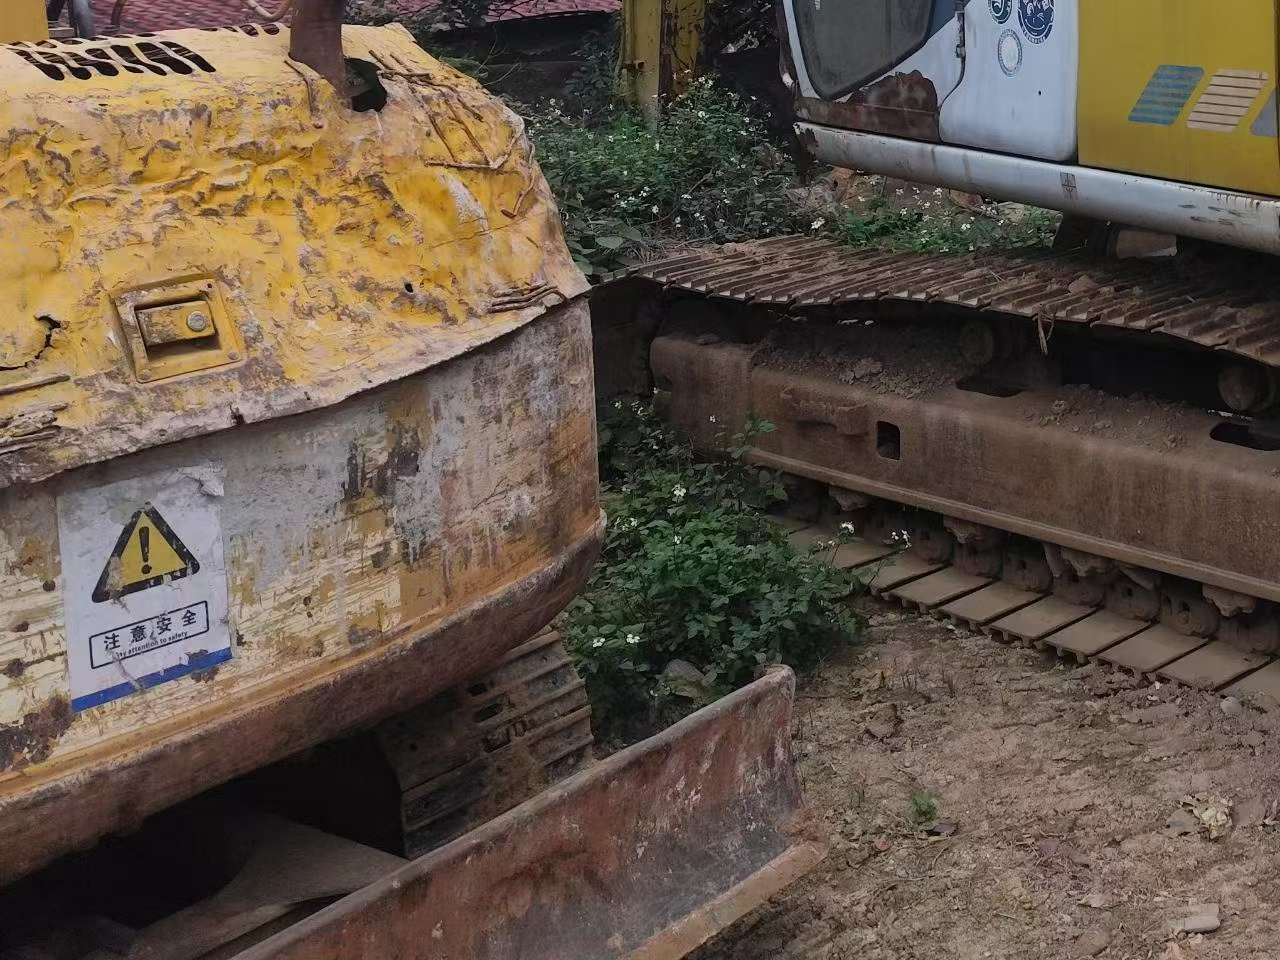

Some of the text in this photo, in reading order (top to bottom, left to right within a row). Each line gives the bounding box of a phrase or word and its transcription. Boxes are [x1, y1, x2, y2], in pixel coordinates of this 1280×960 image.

[103, 609, 196, 651] 注意安全
[160, 637, 168, 645] to
[168, 630, 188, 643] safety
